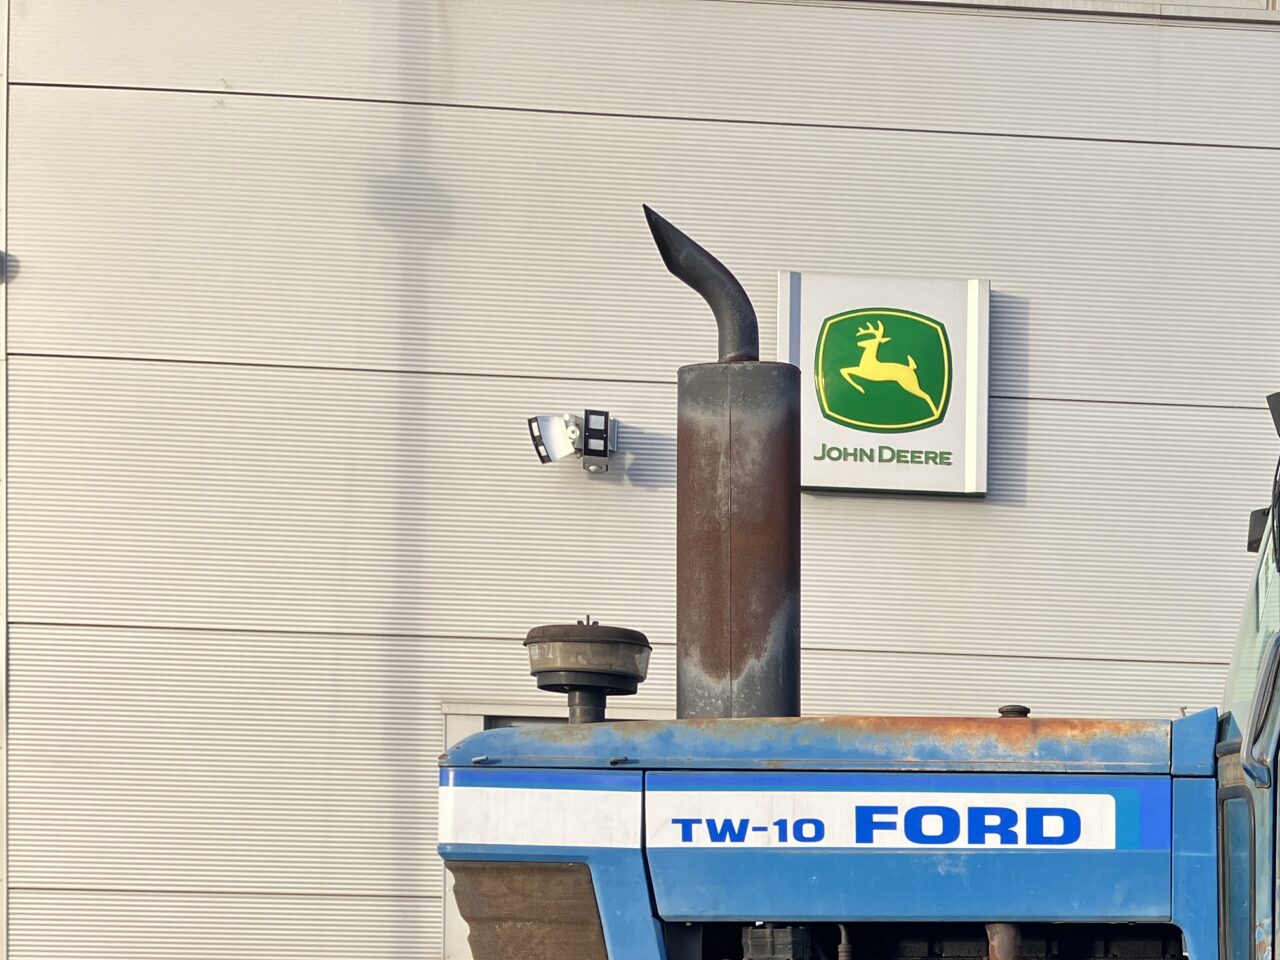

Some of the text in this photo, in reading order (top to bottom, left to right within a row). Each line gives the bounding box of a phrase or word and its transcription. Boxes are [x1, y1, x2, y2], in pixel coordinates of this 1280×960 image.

[814, 443, 953, 466] JOHN DEERE
[671, 805, 1081, 846] TW-10 FORD
